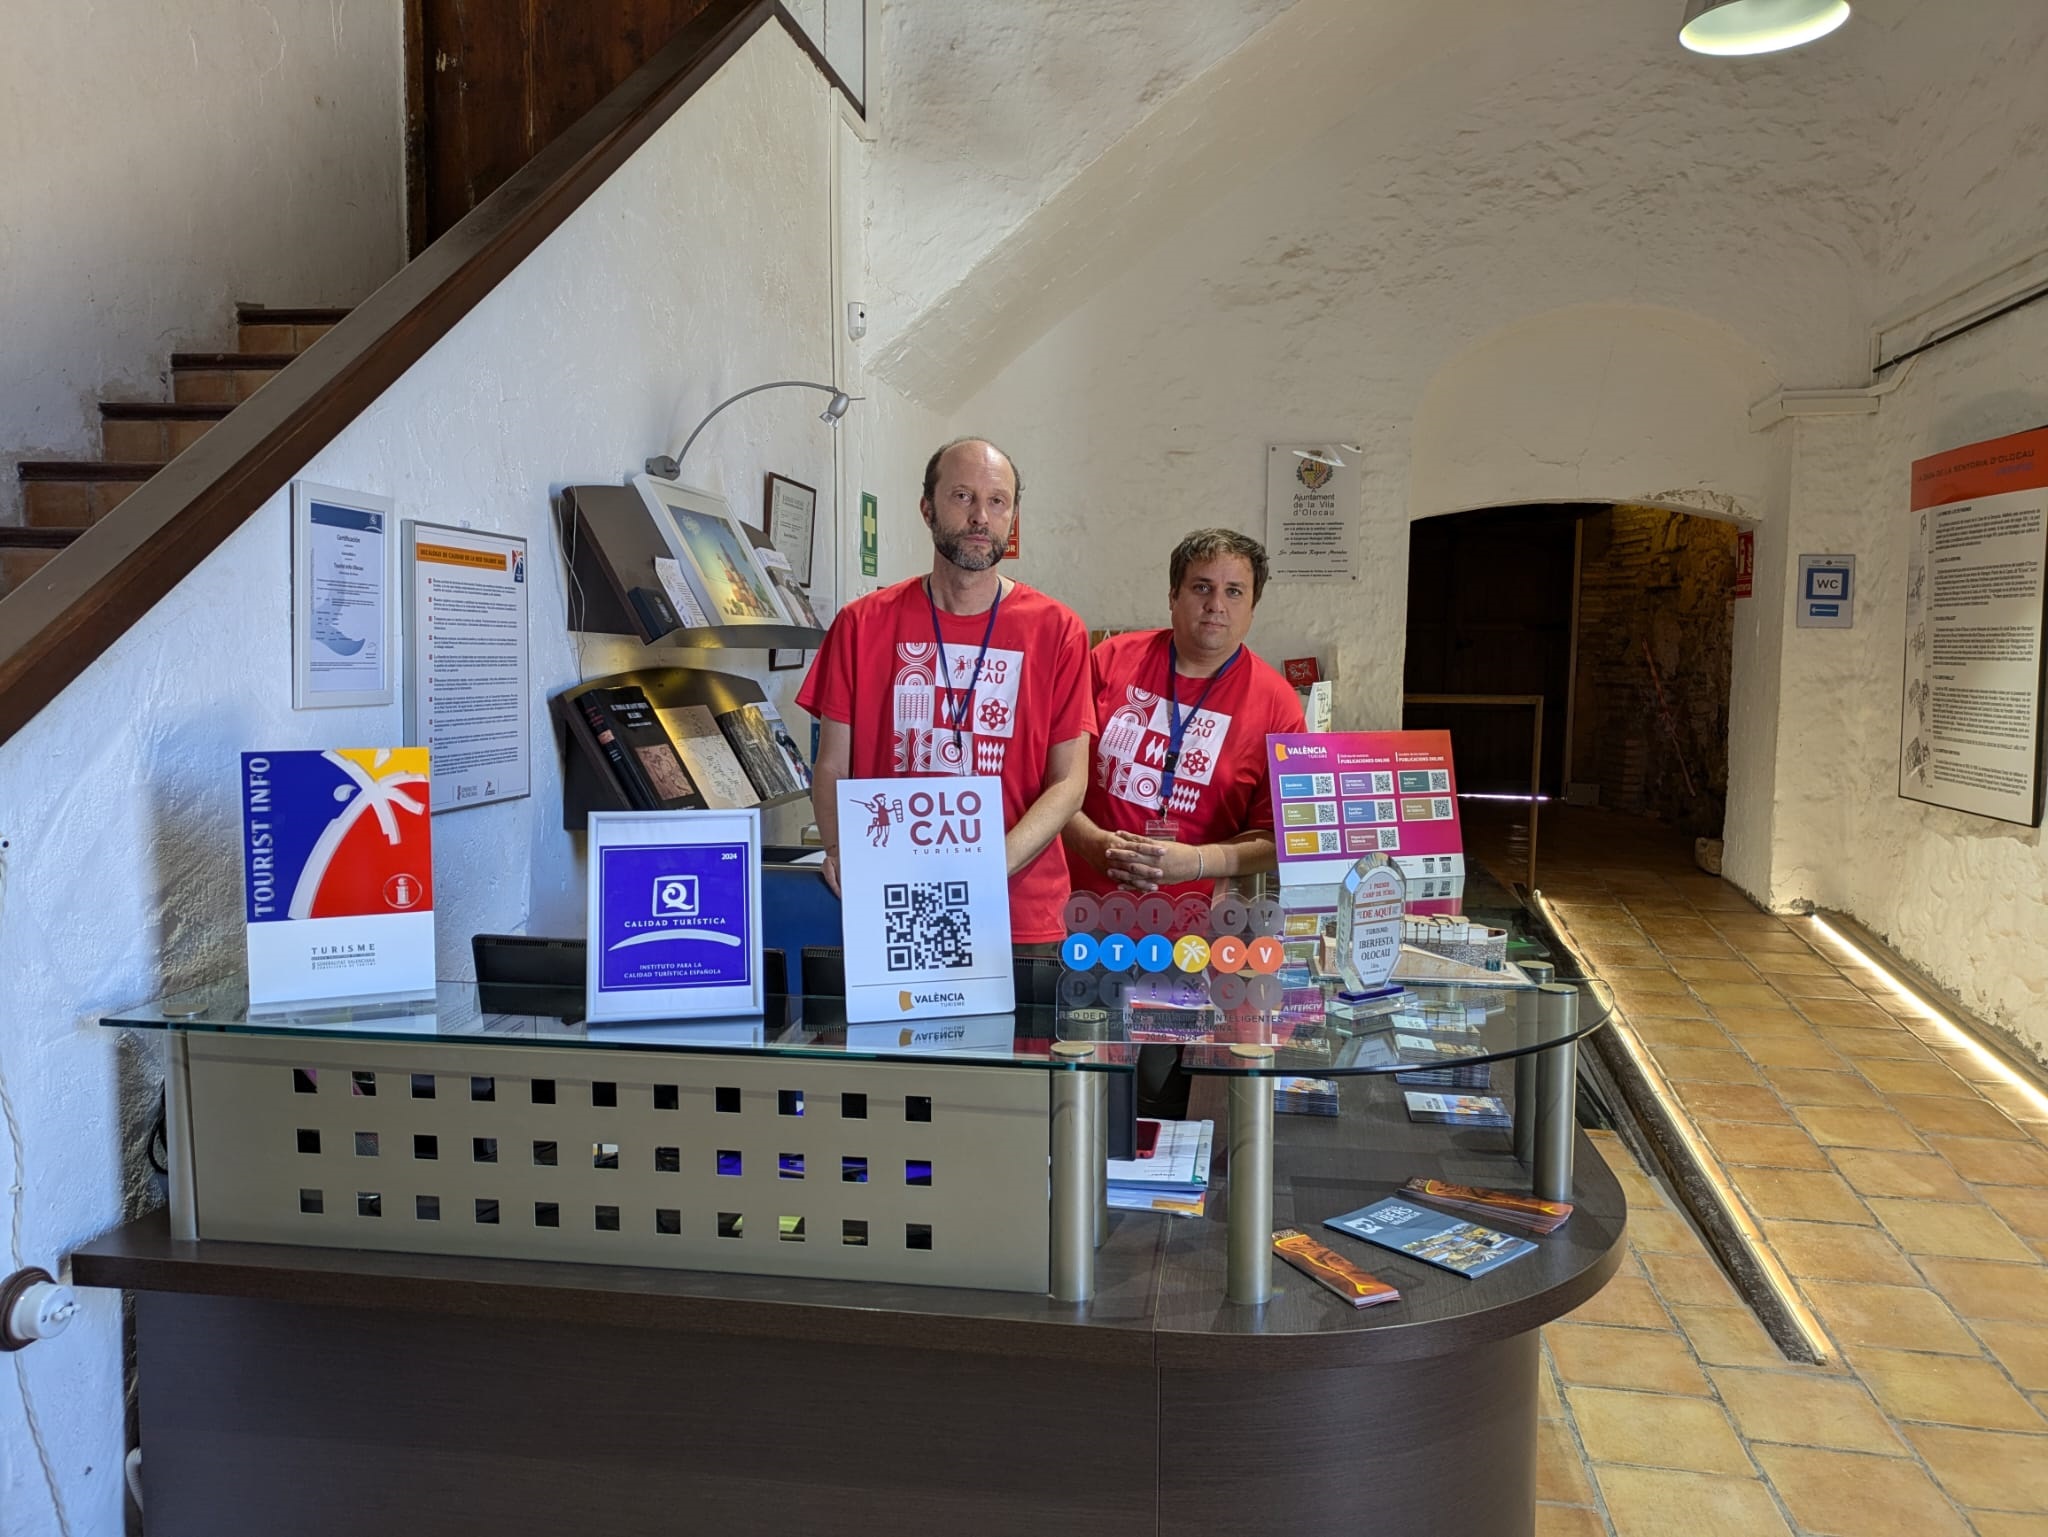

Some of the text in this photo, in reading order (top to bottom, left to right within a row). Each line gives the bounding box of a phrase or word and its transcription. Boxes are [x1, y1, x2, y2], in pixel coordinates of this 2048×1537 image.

[1293, 493, 1335, 502] Ajuntament
[1817, 579, 1839, 590] WC
[1287, 745, 1328, 755] VALÈNCIA
[908, 790, 982, 818] OLO
[249, 757, 275, 918] TOURIST INFO
[910, 818, 981, 847] CAU
[721, 852, 738, 861] 2024
[913, 847, 983, 855] TURISME
[1363, 909, 1373, 919] DE
[624, 916, 726, 928] CALIDAD TURÍSTICA
[1359, 936, 1394, 950] IBERFESTA
[312, 943, 376, 956] TURISME
[1361, 948, 1391, 961] OLOCAU
[640, 963, 675, 971] INSTITUTO
[654, 969, 688, 977] TURÍSTICA
[689, 968, 721, 976] ESPAÑOLA
[914, 991, 965, 1004] VALÈNCIA
